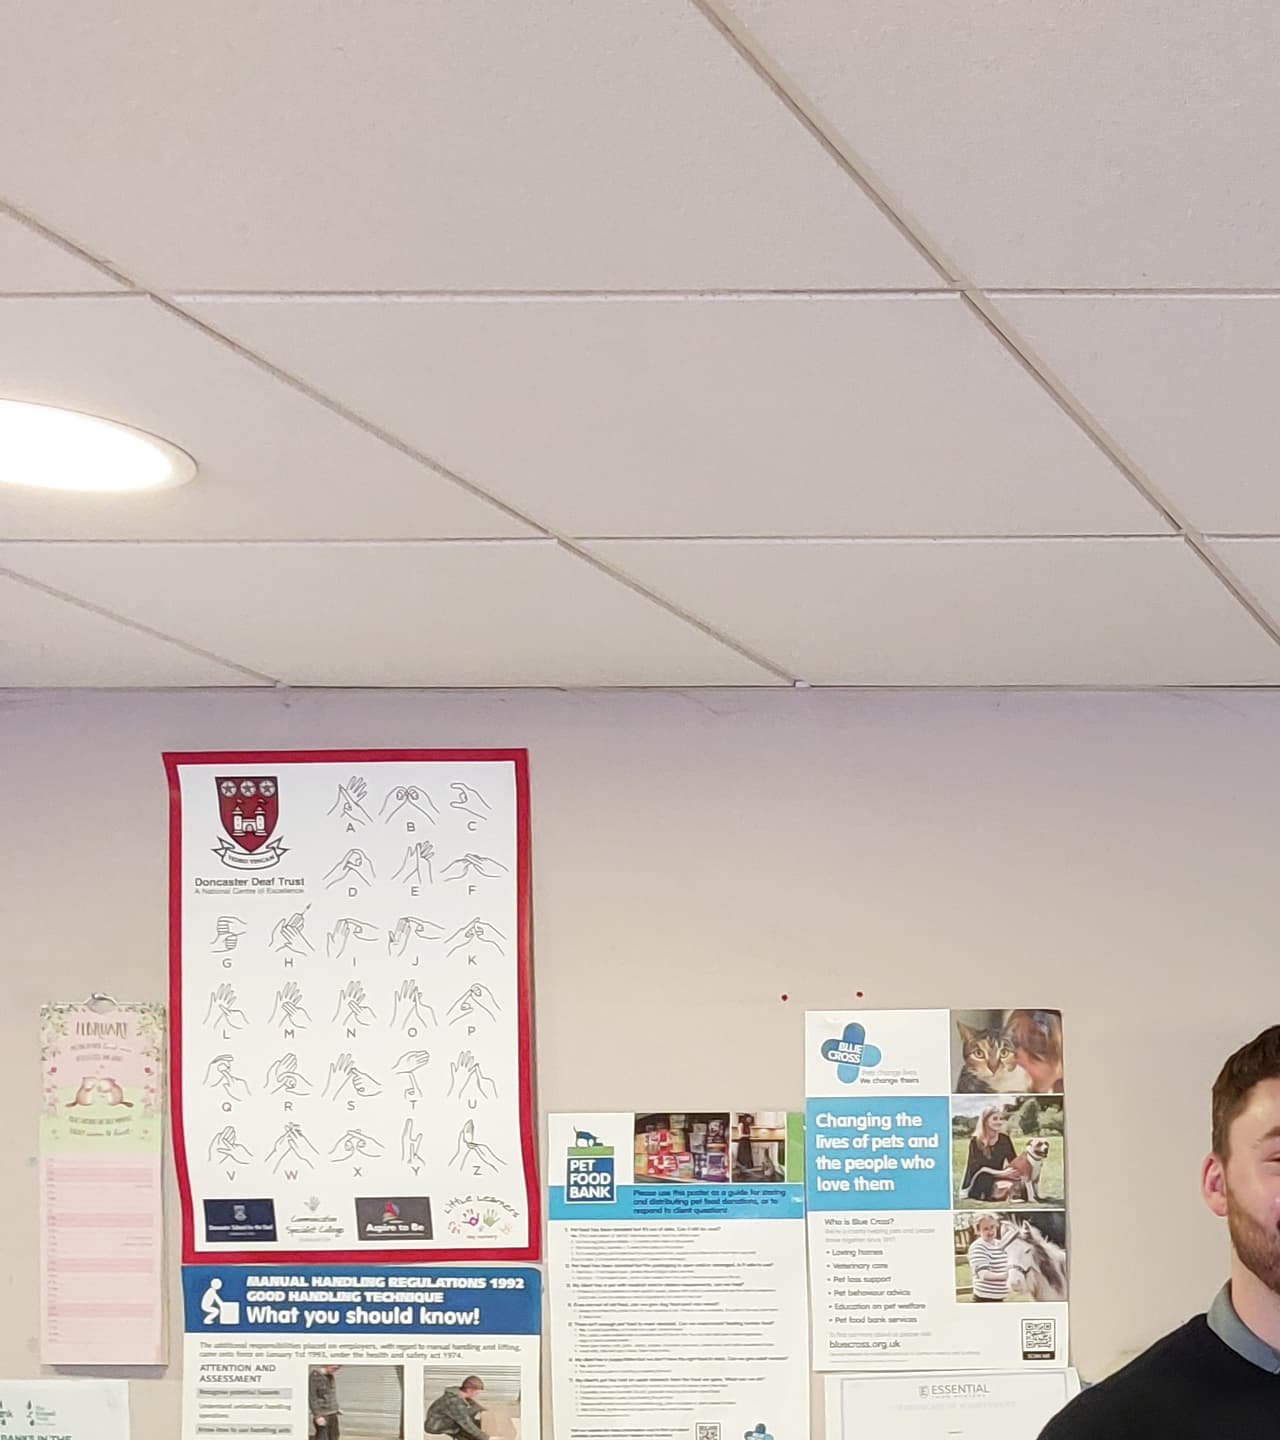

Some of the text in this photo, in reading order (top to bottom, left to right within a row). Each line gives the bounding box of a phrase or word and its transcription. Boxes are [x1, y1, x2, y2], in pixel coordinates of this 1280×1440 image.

[346, 821, 476, 832] A B C
[195, 878, 304, 887] Doncaster Deaf Trust
[349, 885, 476, 897] D E F
[223, 956, 476, 968] G H I J K
[223, 1026, 475, 1039] L M N O P
[839, 1042, 864, 1054] BLUE
[828, 1052, 861, 1063] CROSS
[222, 1100, 477, 1112] Q R S T U
[816, 1112, 922, 1130] Changing the
[816, 1134, 939, 1152] lives of pets and
[570, 1160, 595, 1171] PET
[816, 1155, 935, 1173] the people who
[227, 1166, 482, 1180] V W X Y Z
[570, 1173, 611, 1185] FOOD
[817, 1177, 894, 1191] love them
[570, 1186, 611, 1198] BANK
[246, 1276, 524, 1289] MANUAL HANDLING REGULATIONS 1992
[246, 1291, 444, 1303] GOOD HANDLING TECHNIQUE
[246, 1307, 480, 1328] What you should know!
[200, 1364, 276, 1372] ATTENTION AND
[200, 1375, 262, 1383] ASSESSMENT
[932, 1384, 990, 1394] ESSENTIAL
